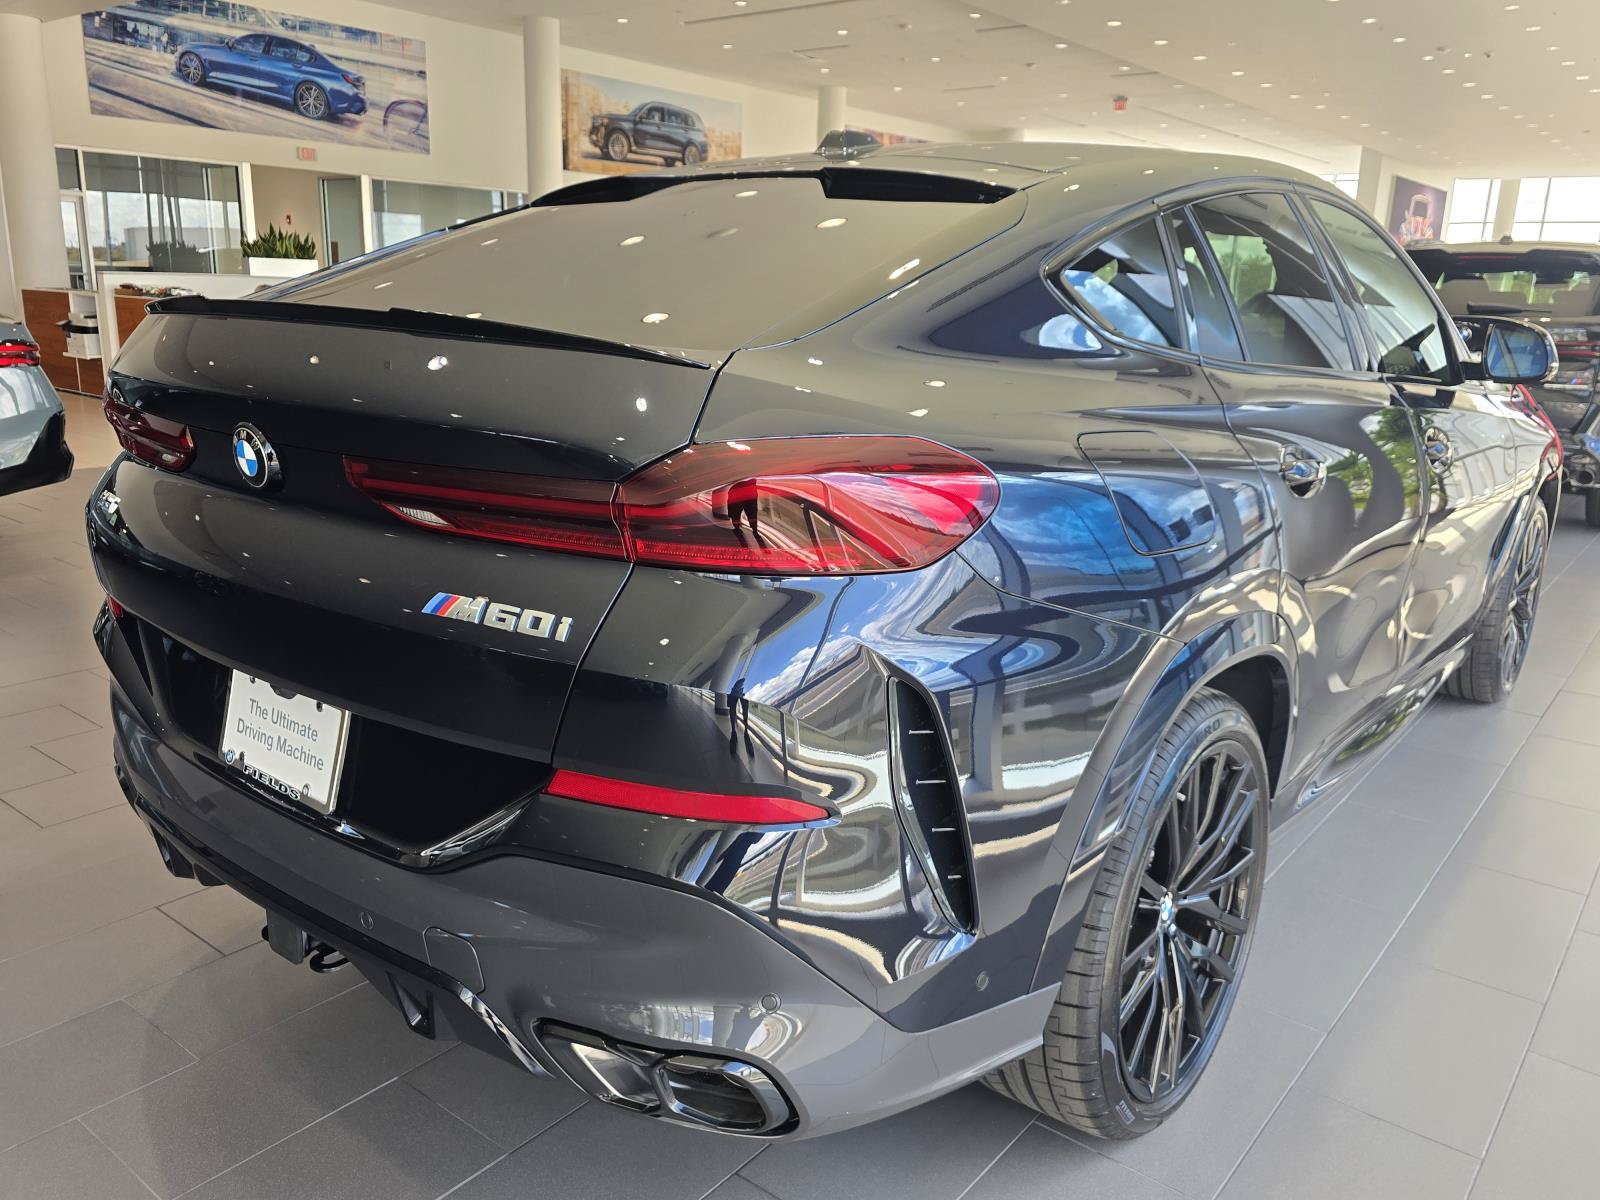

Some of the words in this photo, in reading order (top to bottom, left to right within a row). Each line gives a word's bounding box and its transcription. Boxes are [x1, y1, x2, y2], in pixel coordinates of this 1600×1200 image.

[249, 698, 268, 720] The
[271, 707, 318, 742] Ultimate
[236, 718, 274, 751] Driving
[276, 735, 324, 771] Machine
[243, 764, 301, 800] FIELDS
